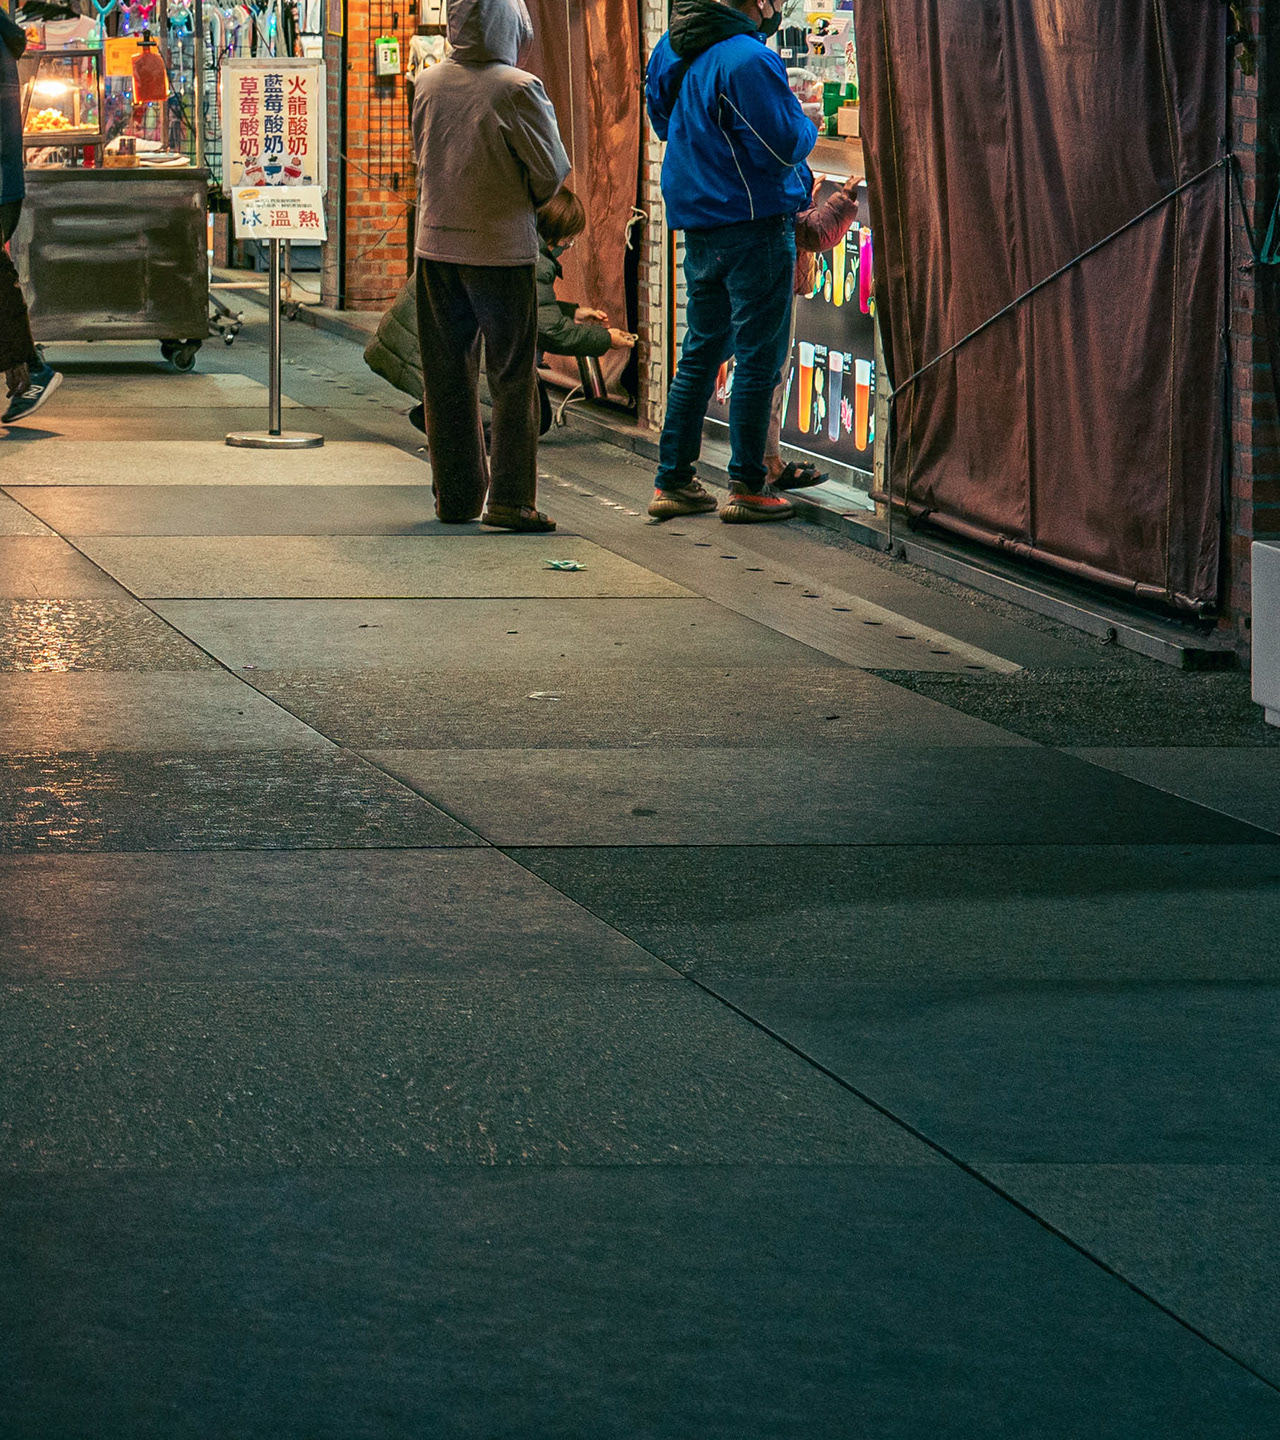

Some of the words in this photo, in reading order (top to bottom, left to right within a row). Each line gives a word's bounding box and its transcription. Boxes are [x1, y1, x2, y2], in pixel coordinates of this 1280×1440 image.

[239, 76, 260, 157] 草莓酸奶
[263, 73, 284, 155] 藍莓酸奶
[287, 74, 308, 156] 火龍酸奶
[241, 210, 320, 228] 冰溫熱
